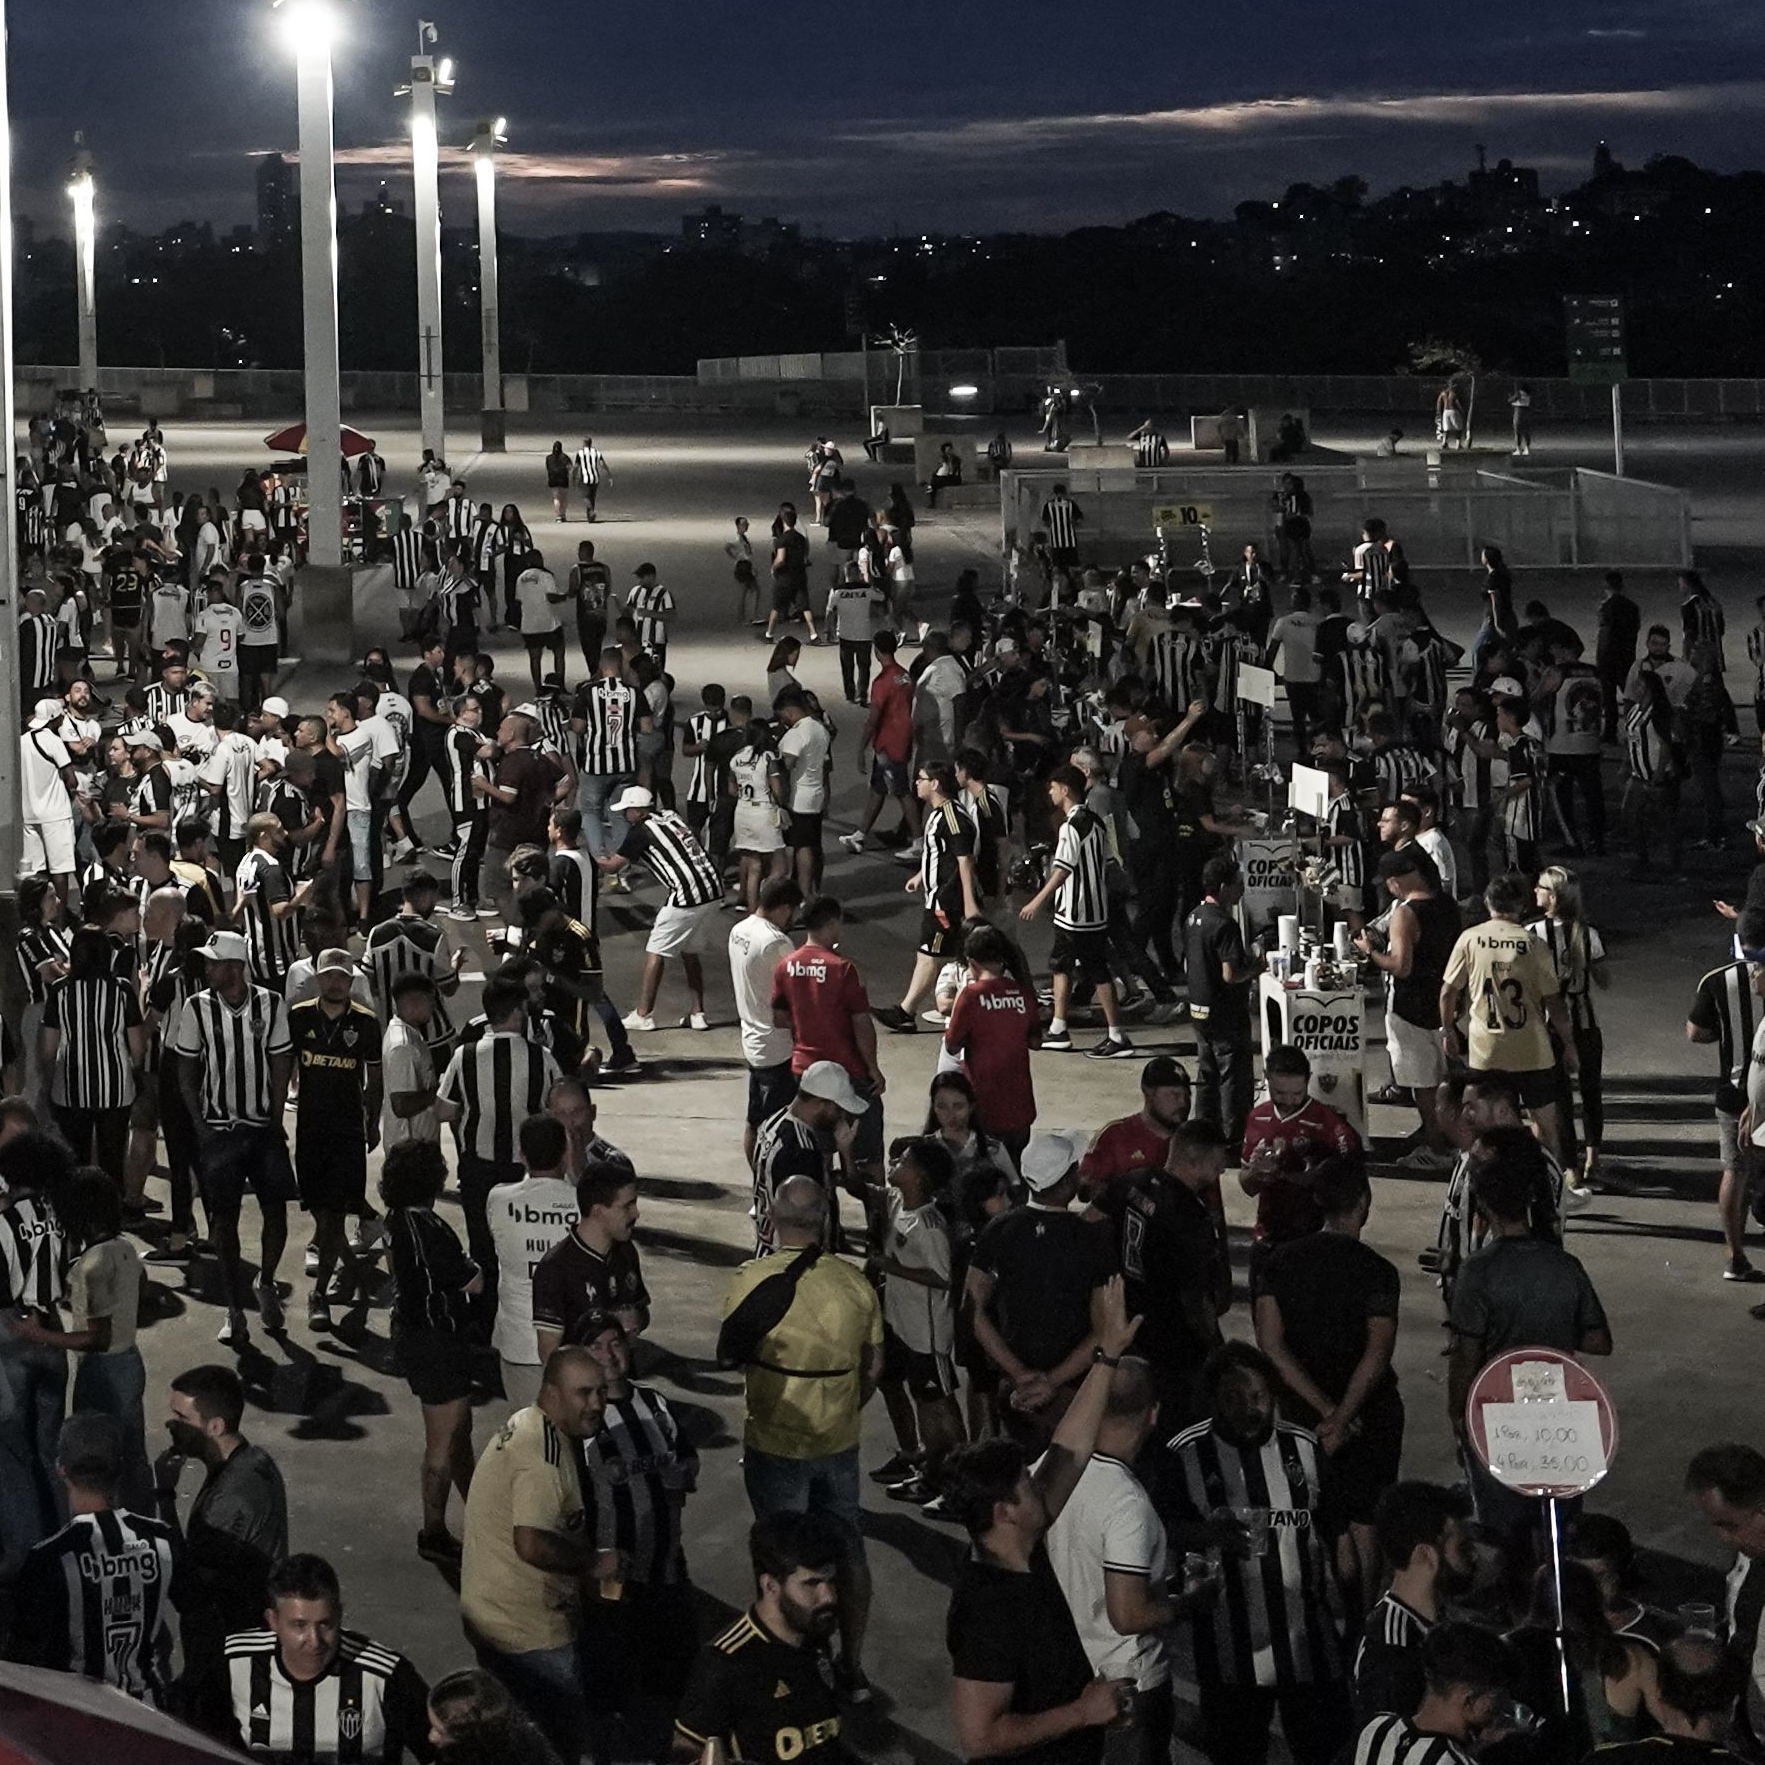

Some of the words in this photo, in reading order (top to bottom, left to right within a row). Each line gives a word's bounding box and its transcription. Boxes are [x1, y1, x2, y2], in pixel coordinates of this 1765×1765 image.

[1488, 935, 1527, 955] bmg
[796, 960, 828, 984] bmg
[990, 992, 1027, 1015] bmg
[1484, 977, 1528, 1030] 13
[1292, 1015, 1360, 1035] COPOS
[1293, 1035, 1360, 1052] OFICIAIS
[312, 1054, 359, 1070] BETANO
[1270, 1510, 1311, 1529] TANO
[101, 1550, 157, 1581] bmg
[105, 1621, 142, 1693] 7
